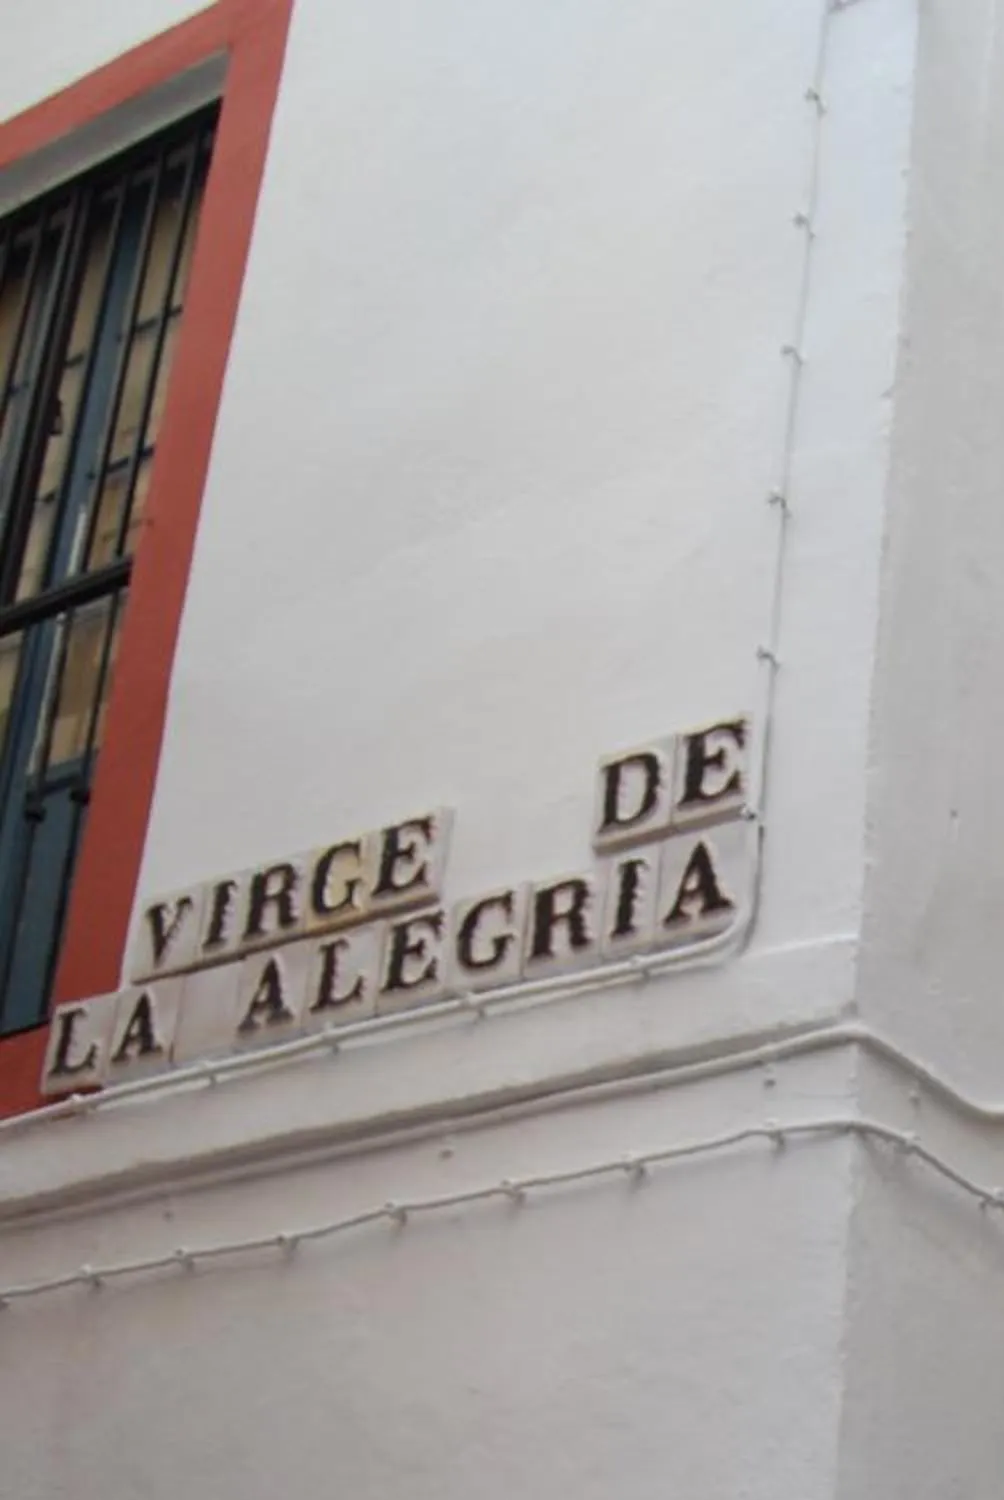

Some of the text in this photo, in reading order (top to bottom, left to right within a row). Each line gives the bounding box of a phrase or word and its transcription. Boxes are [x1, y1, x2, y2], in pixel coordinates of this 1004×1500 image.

[50, 842, 735, 1077] LA ALEGRIA
[145, 720, 747, 968] VIRGE DE
